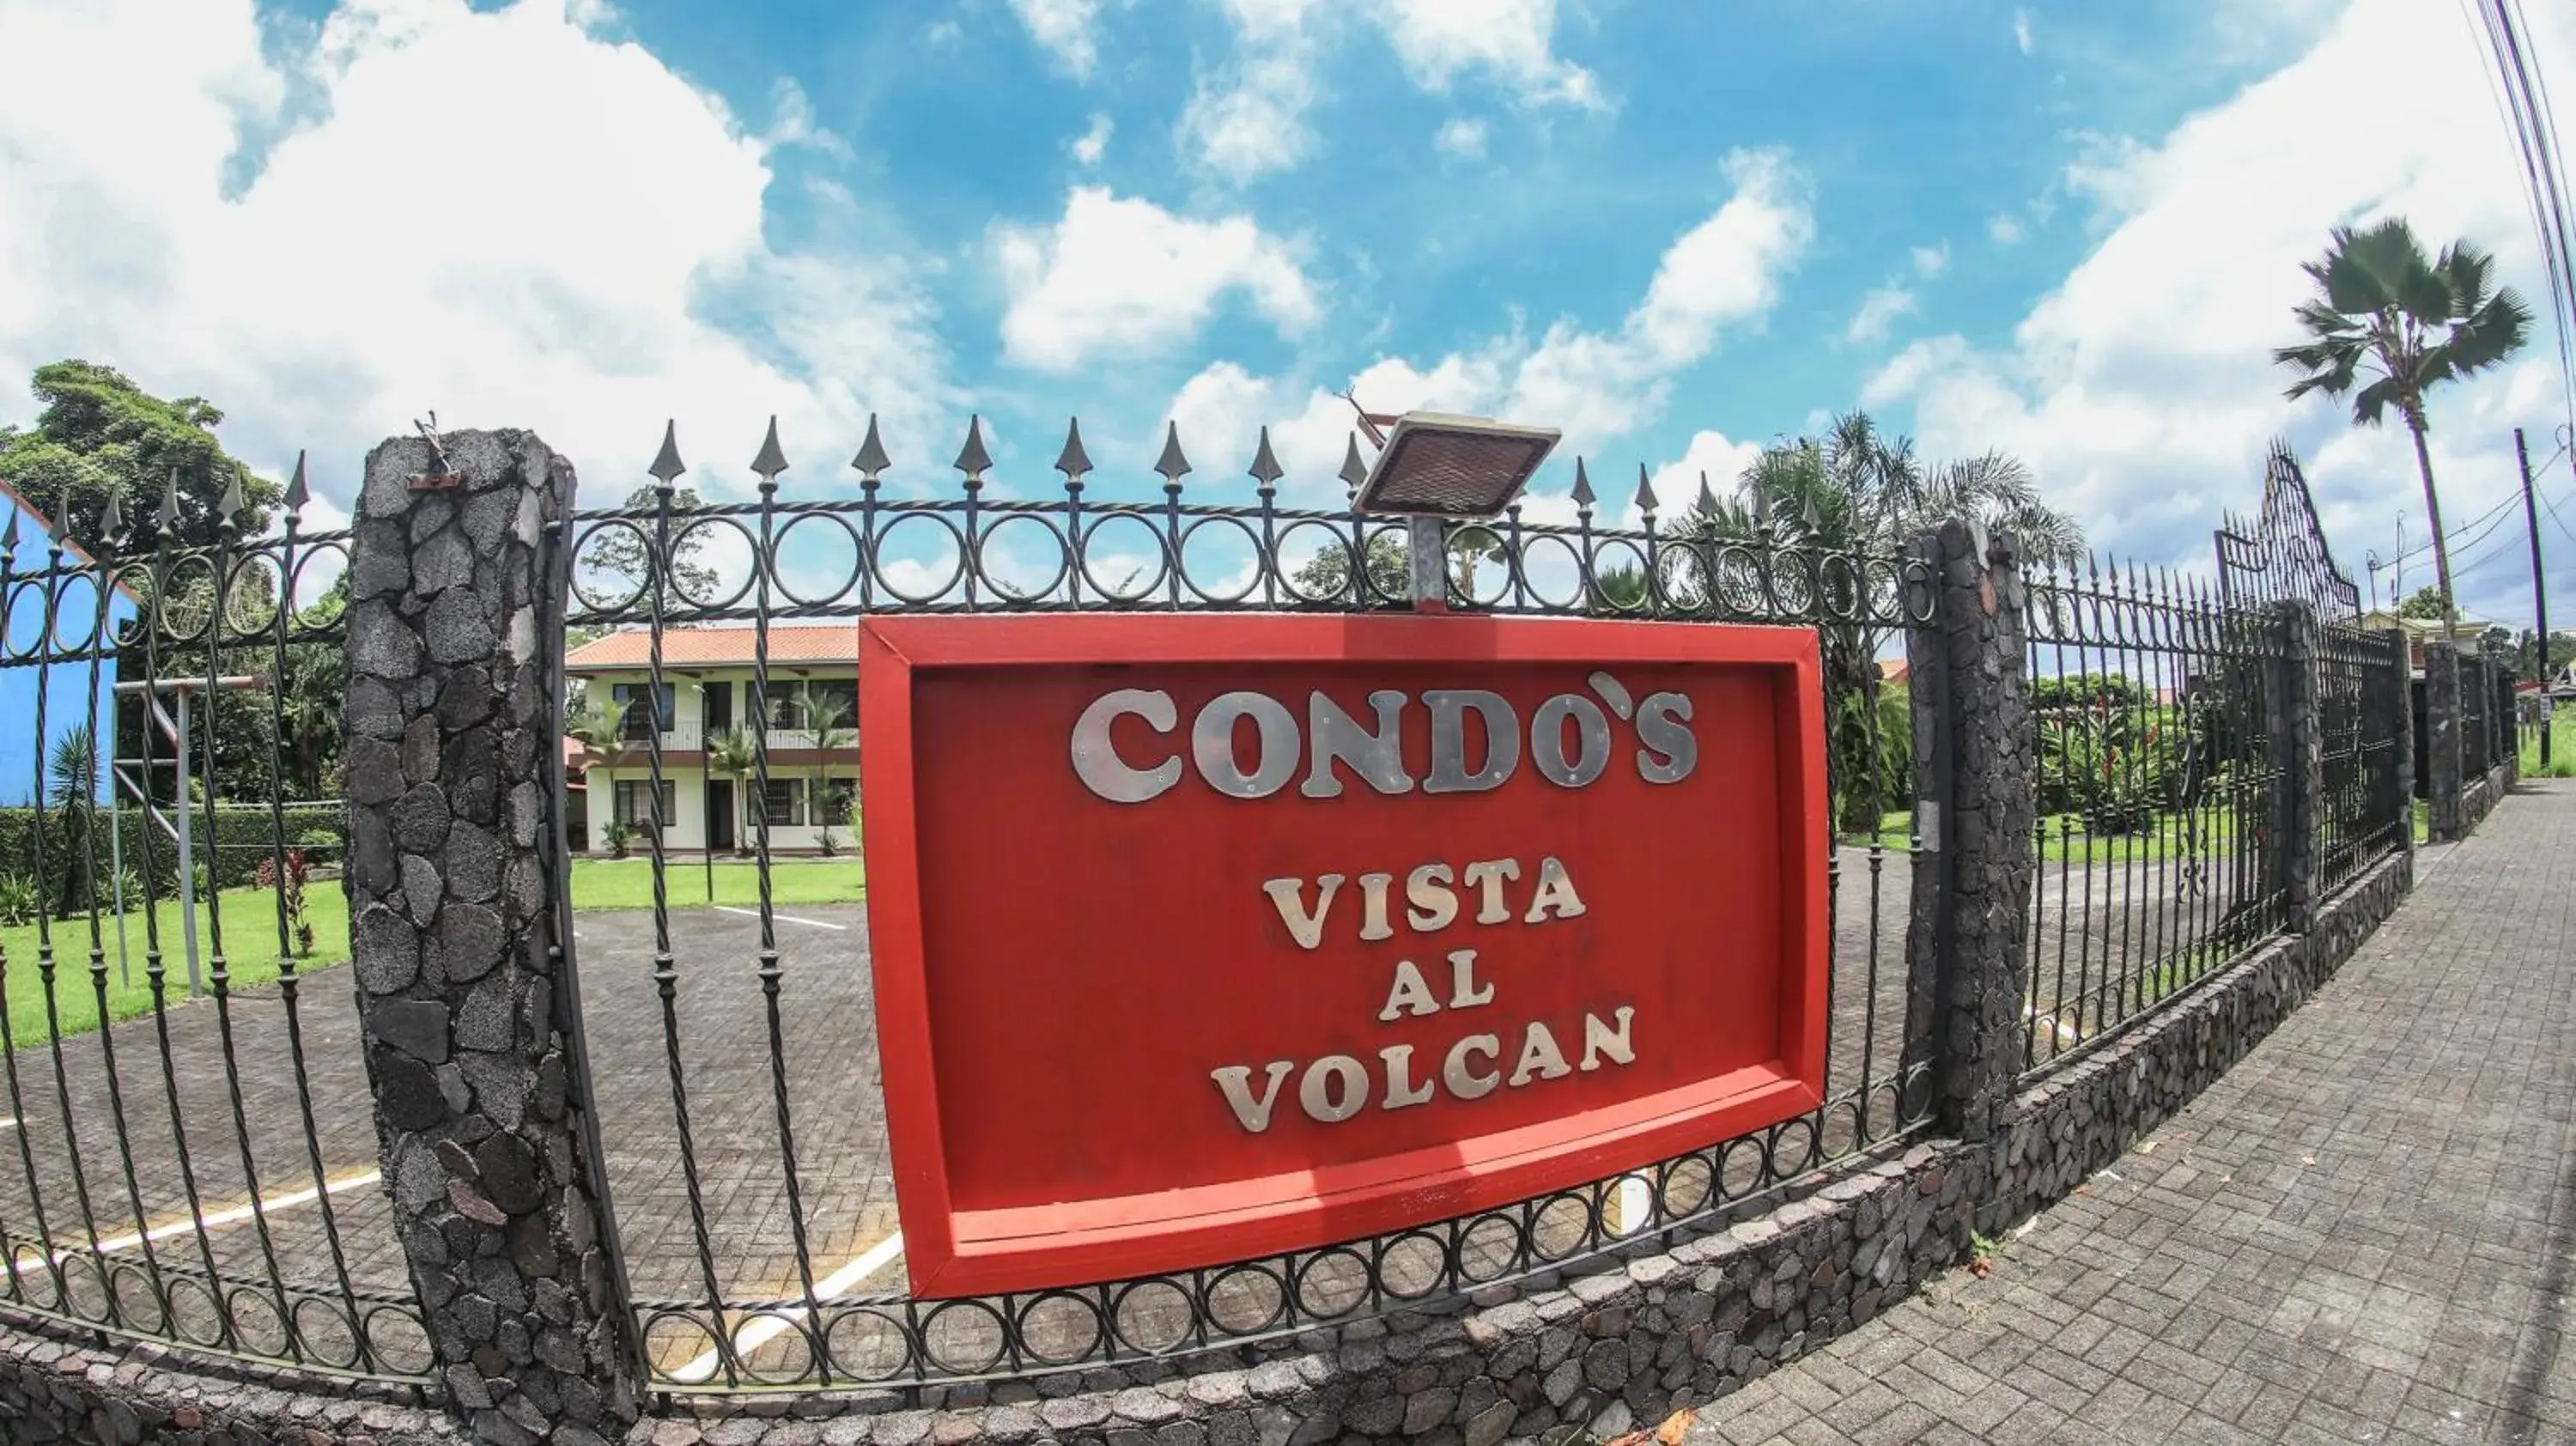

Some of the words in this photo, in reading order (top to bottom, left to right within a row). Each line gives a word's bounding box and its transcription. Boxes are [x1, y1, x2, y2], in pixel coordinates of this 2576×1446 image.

[1262, 857, 1587, 949] VISTA
[1378, 950, 1494, 1022] AL
[1211, 1006, 1636, 1133] VOLCAN
